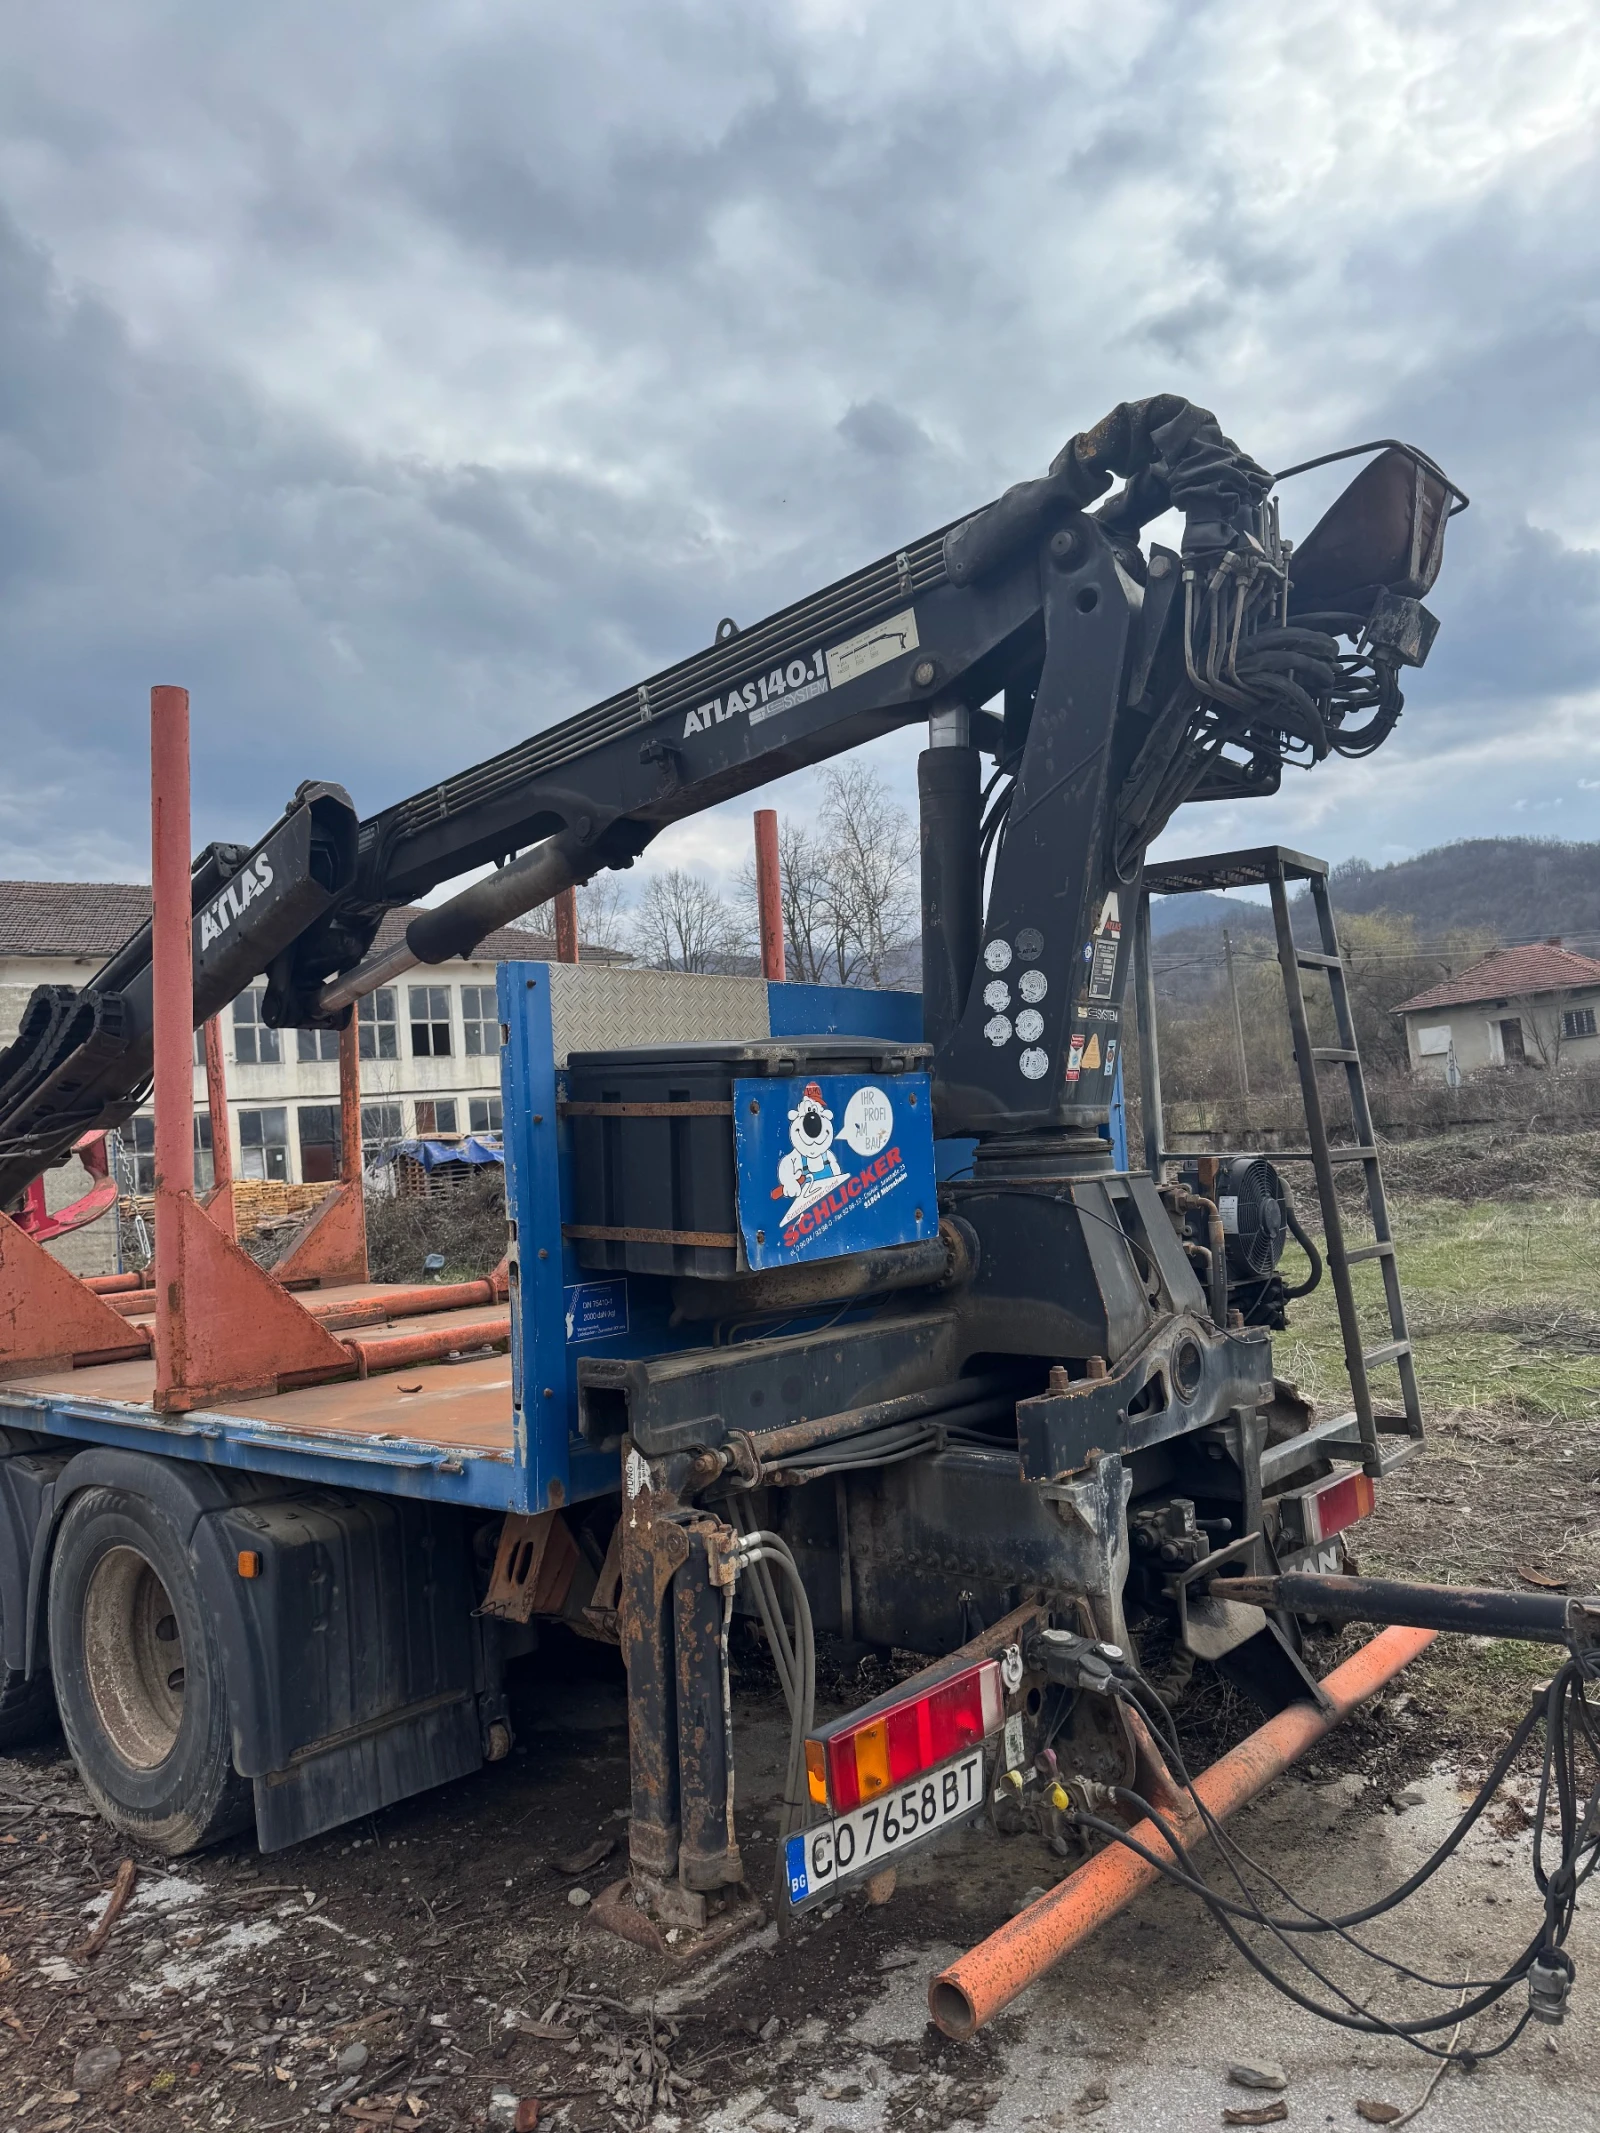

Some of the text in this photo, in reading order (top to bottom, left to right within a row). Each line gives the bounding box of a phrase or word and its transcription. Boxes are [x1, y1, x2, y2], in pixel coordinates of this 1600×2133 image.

[682, 648, 825, 740] ATLAS 140.1
[783, 676, 829, 709] SYSTEM
[201, 852, 274, 952] ATLAS
[1105, 920, 1122, 932] ATLAS
[860, 1090, 875, 1105] IHR
[864, 1107, 887, 1121] PROFI
[855, 1122, 868, 1138] AM
[865, 1137, 881, 1151] BAU
[783, 1146, 903, 1247] SCHLICKER
[1288, 1545, 1338, 1575] AN
[811, 1758, 978, 1879] CO 7658 BT
[791, 1873, 807, 1894] BG
